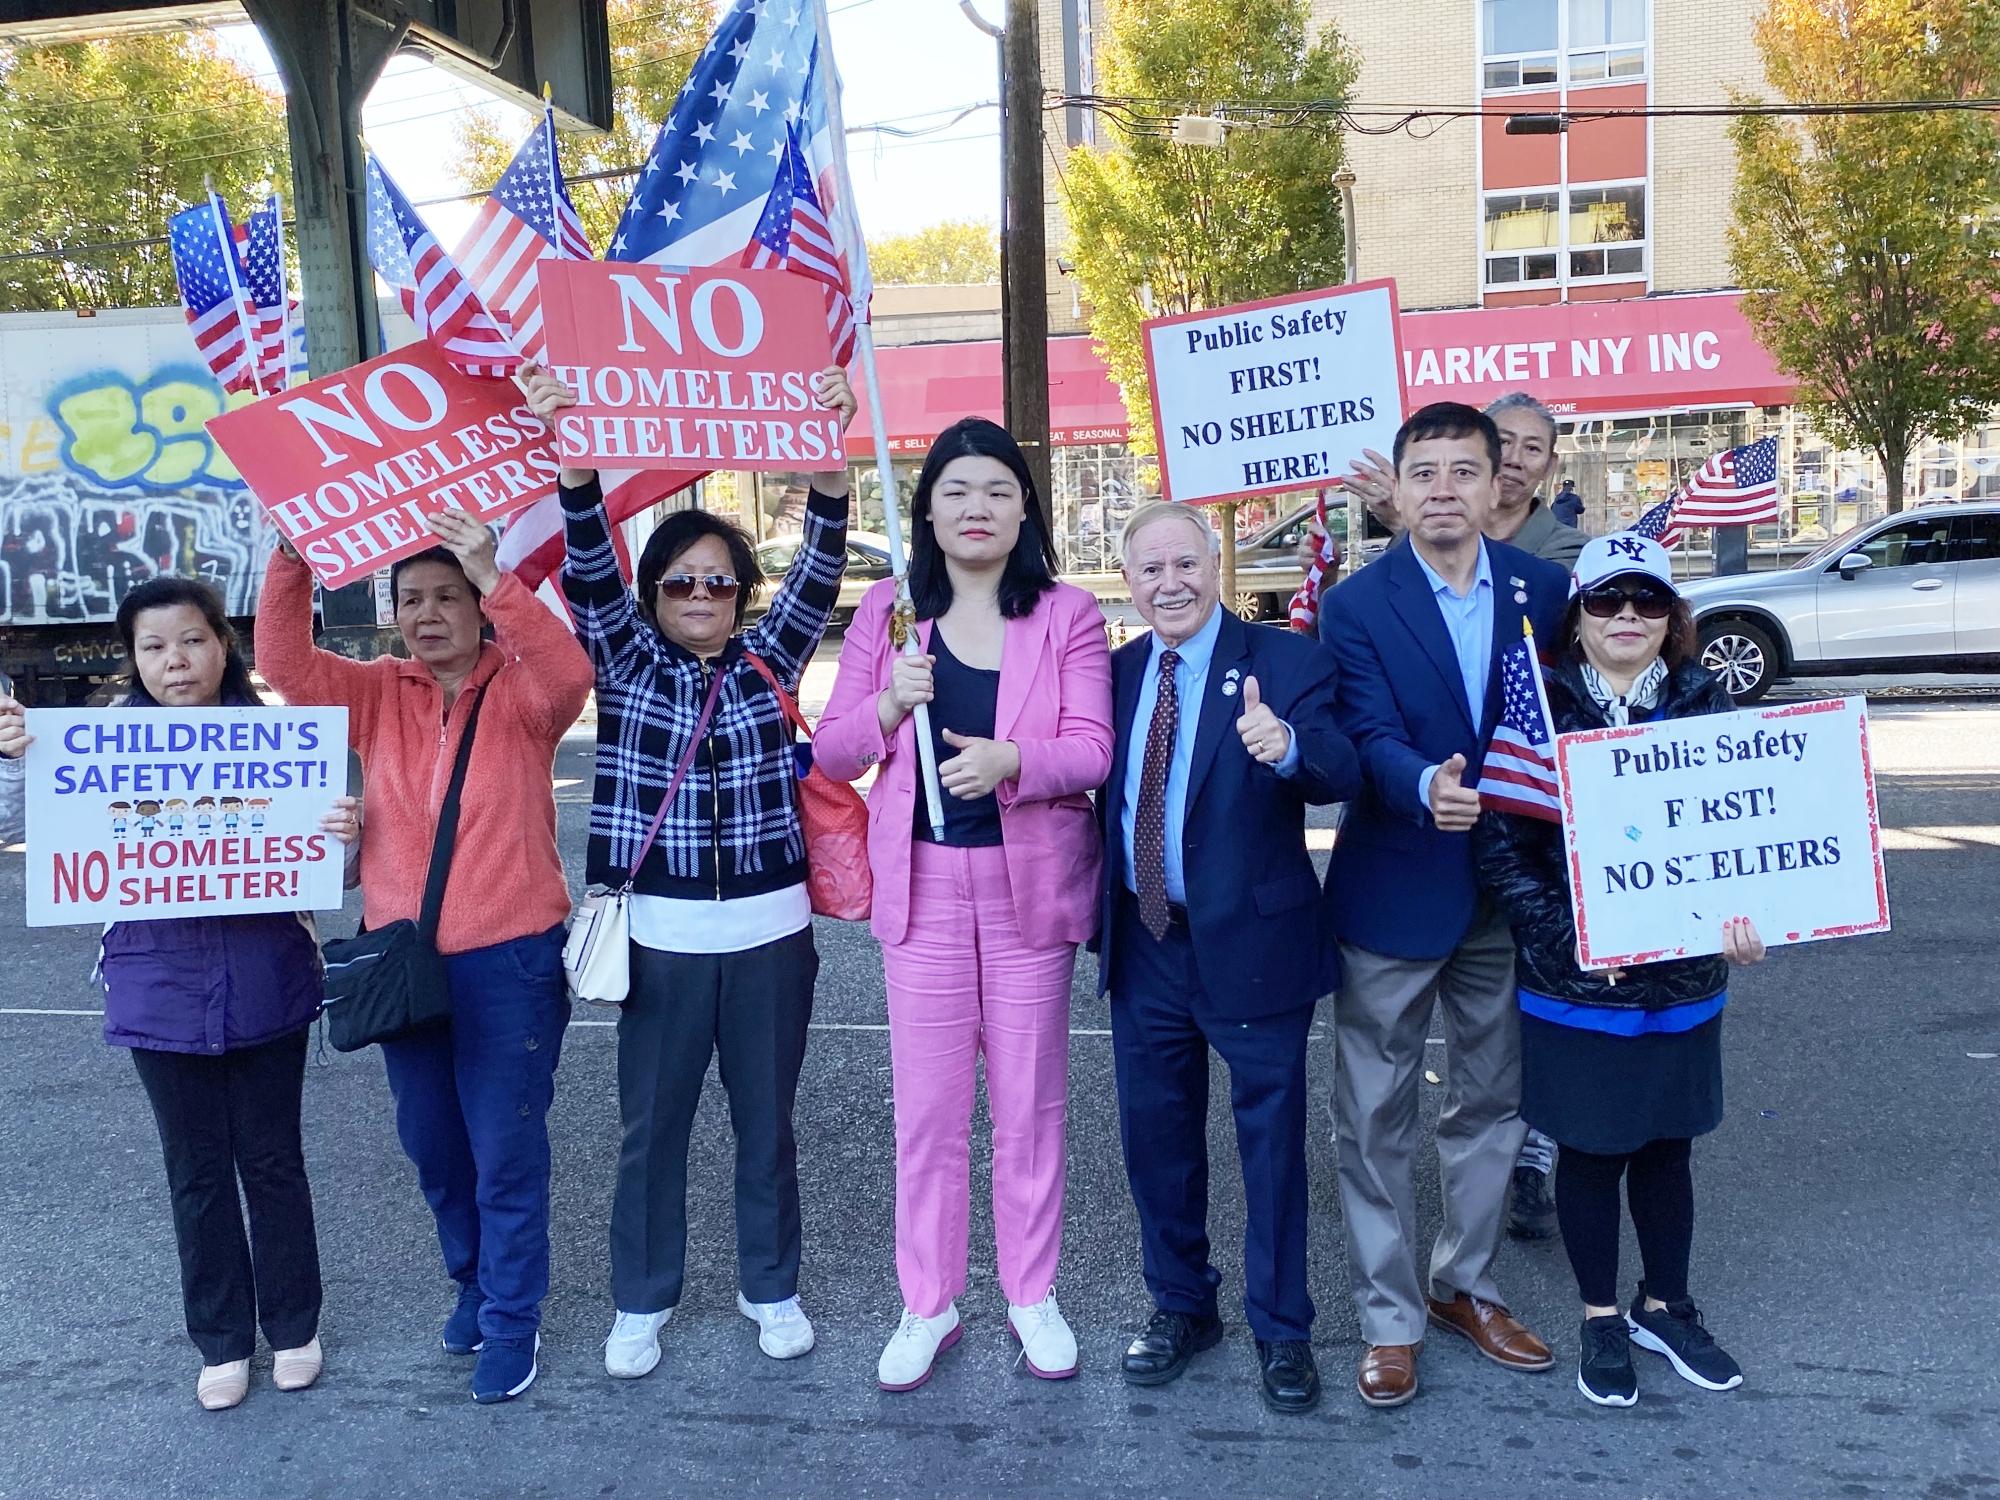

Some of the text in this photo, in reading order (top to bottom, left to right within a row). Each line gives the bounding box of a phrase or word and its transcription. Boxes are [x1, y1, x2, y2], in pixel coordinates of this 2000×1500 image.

[608, 273, 765, 358] NO
[1186, 307, 1348, 354] Public Safety
[1228, 356, 1321, 395] FIRST!
[1570, 337, 1632, 377] NY
[1648, 330, 1721, 373] INC
[550, 365, 832, 412] HOMELESS
[278, 362, 449, 468] NO
[558, 415, 843, 462] SHELTERS!
[904, 438, 928, 449] SELL
[1049, 431, 1067, 442] EAT,
[1072, 428, 1123, 440] SEASONAL
[1180, 396, 1375, 449] NO SHELTERS
[268, 403, 546, 541] HOMELESS
[1241, 451, 1330, 486] HERE!
[1606, 536, 1648, 563] NY
[63, 721, 320, 754] CHILDREN'S
[1611, 729, 1809, 777] Public Safety
[54, 760, 328, 795] SAFETY FIRST!
[1663, 786, 1777, 828] FRST!
[117, 834, 327, 870] HOMELESS
[1602, 835, 1842, 894] NO SELTERS
[53, 850, 110, 904] NO
[118, 870, 299, 906] SHELTER!
